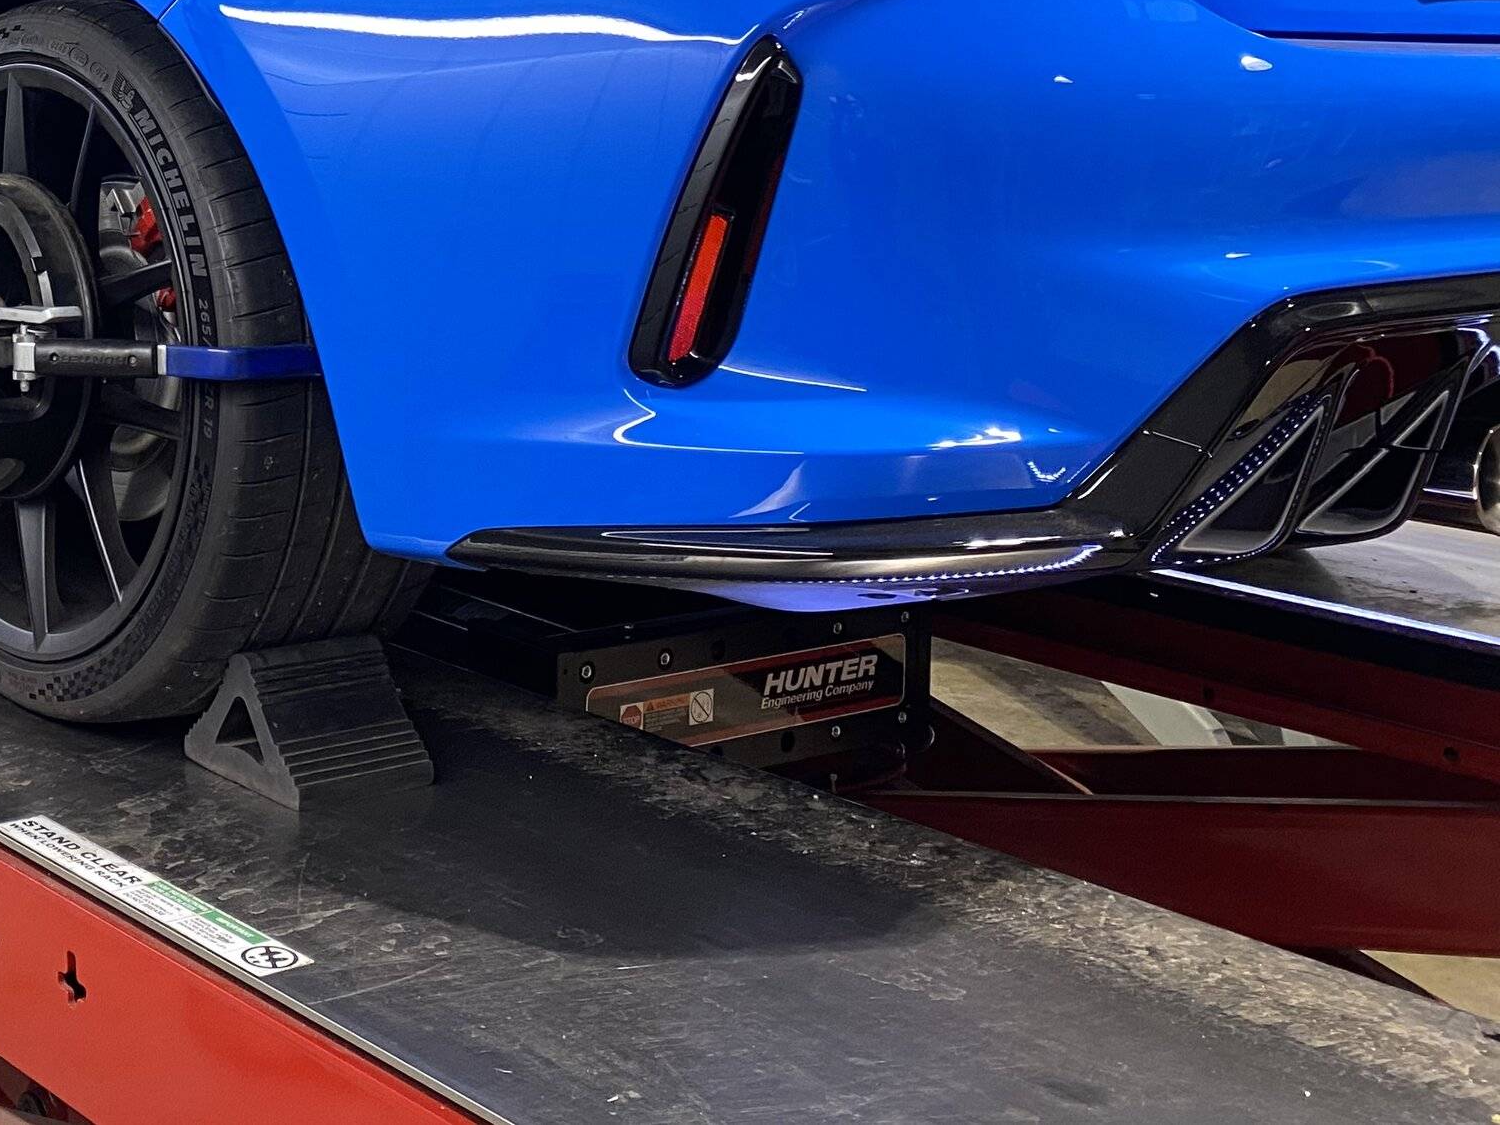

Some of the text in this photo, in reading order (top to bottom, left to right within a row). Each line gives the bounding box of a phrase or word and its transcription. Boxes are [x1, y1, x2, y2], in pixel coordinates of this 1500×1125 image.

[134, 108, 207, 277] MICHELIN
[761, 680, 874, 709] Engineering Company
[763, 655, 879, 696] HUNTER
[10, 823, 128, 888] WHEN LOWERING RACK
[22, 820, 142, 884] STAND CLEAR
